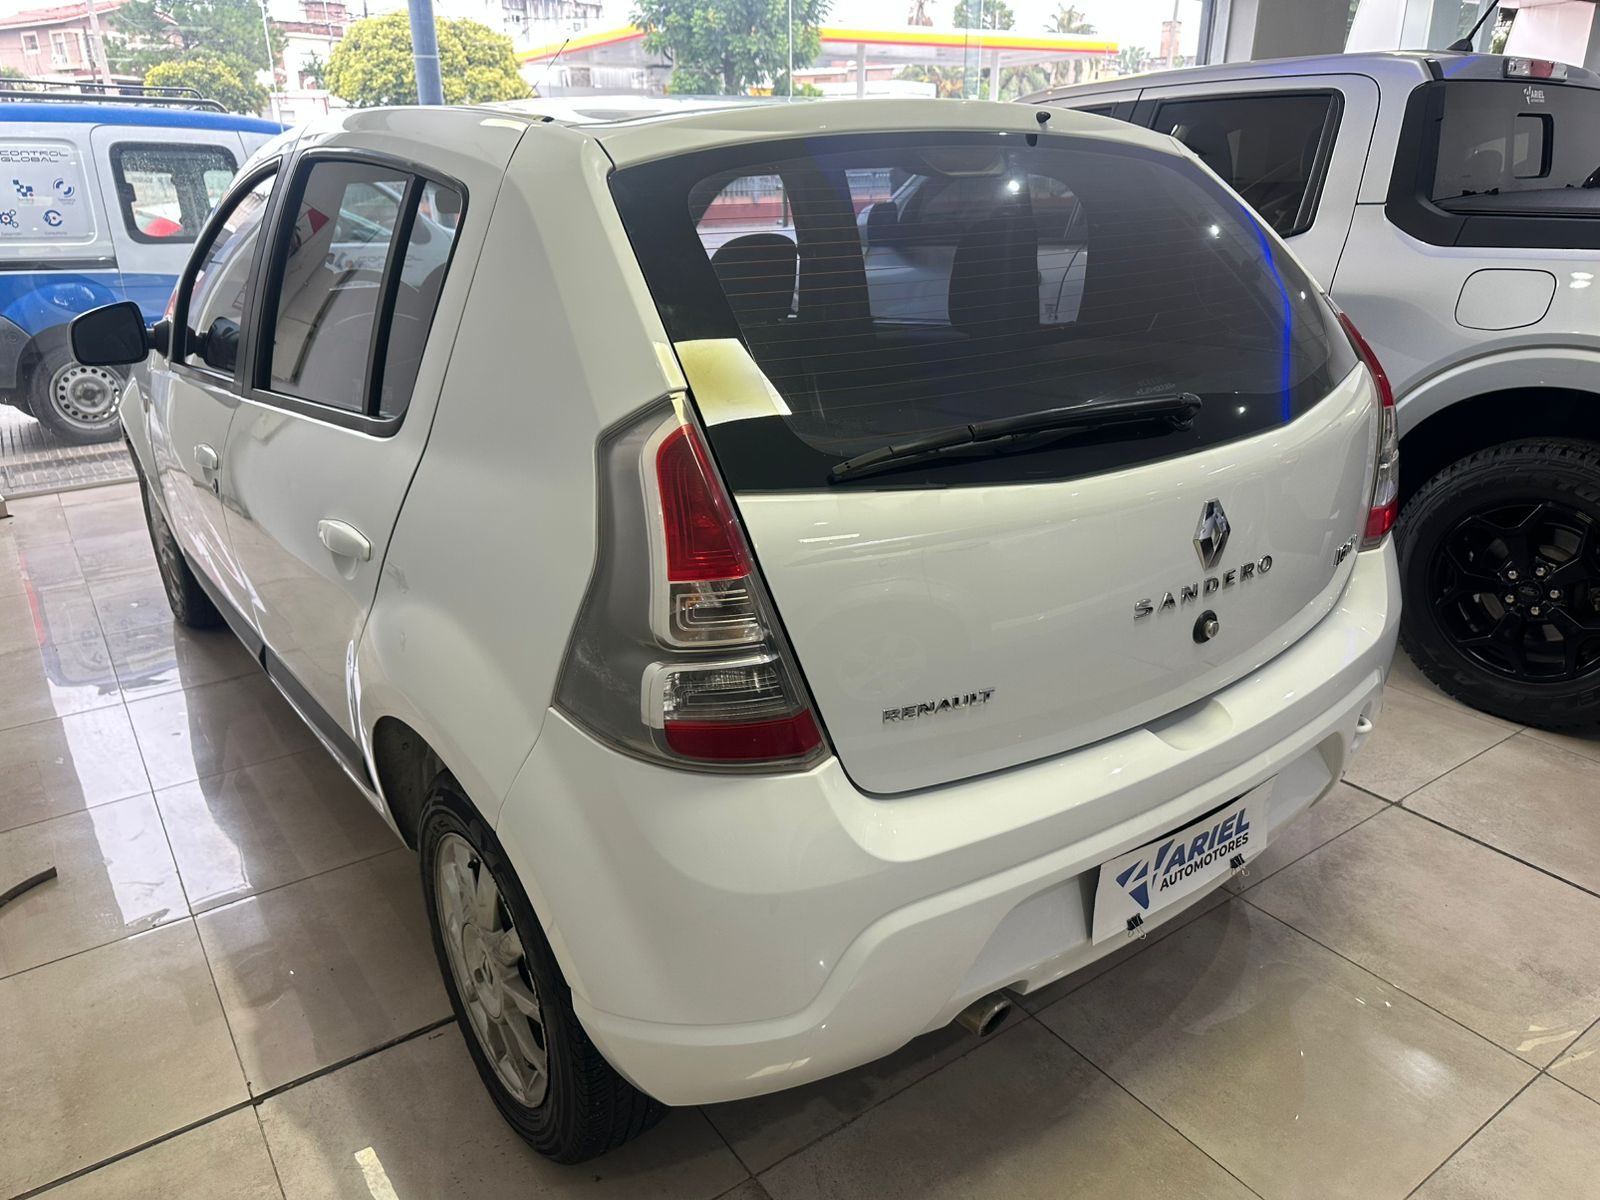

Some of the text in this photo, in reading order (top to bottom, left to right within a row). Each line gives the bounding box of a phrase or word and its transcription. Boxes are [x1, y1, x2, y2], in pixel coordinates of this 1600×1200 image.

[1133, 554, 1273, 620] SANDERO
[882, 687, 996, 724] RENAULT
[1159, 832, 1249, 892] AUTOMOTORES
[1162, 807, 1250, 877] ARIEL
